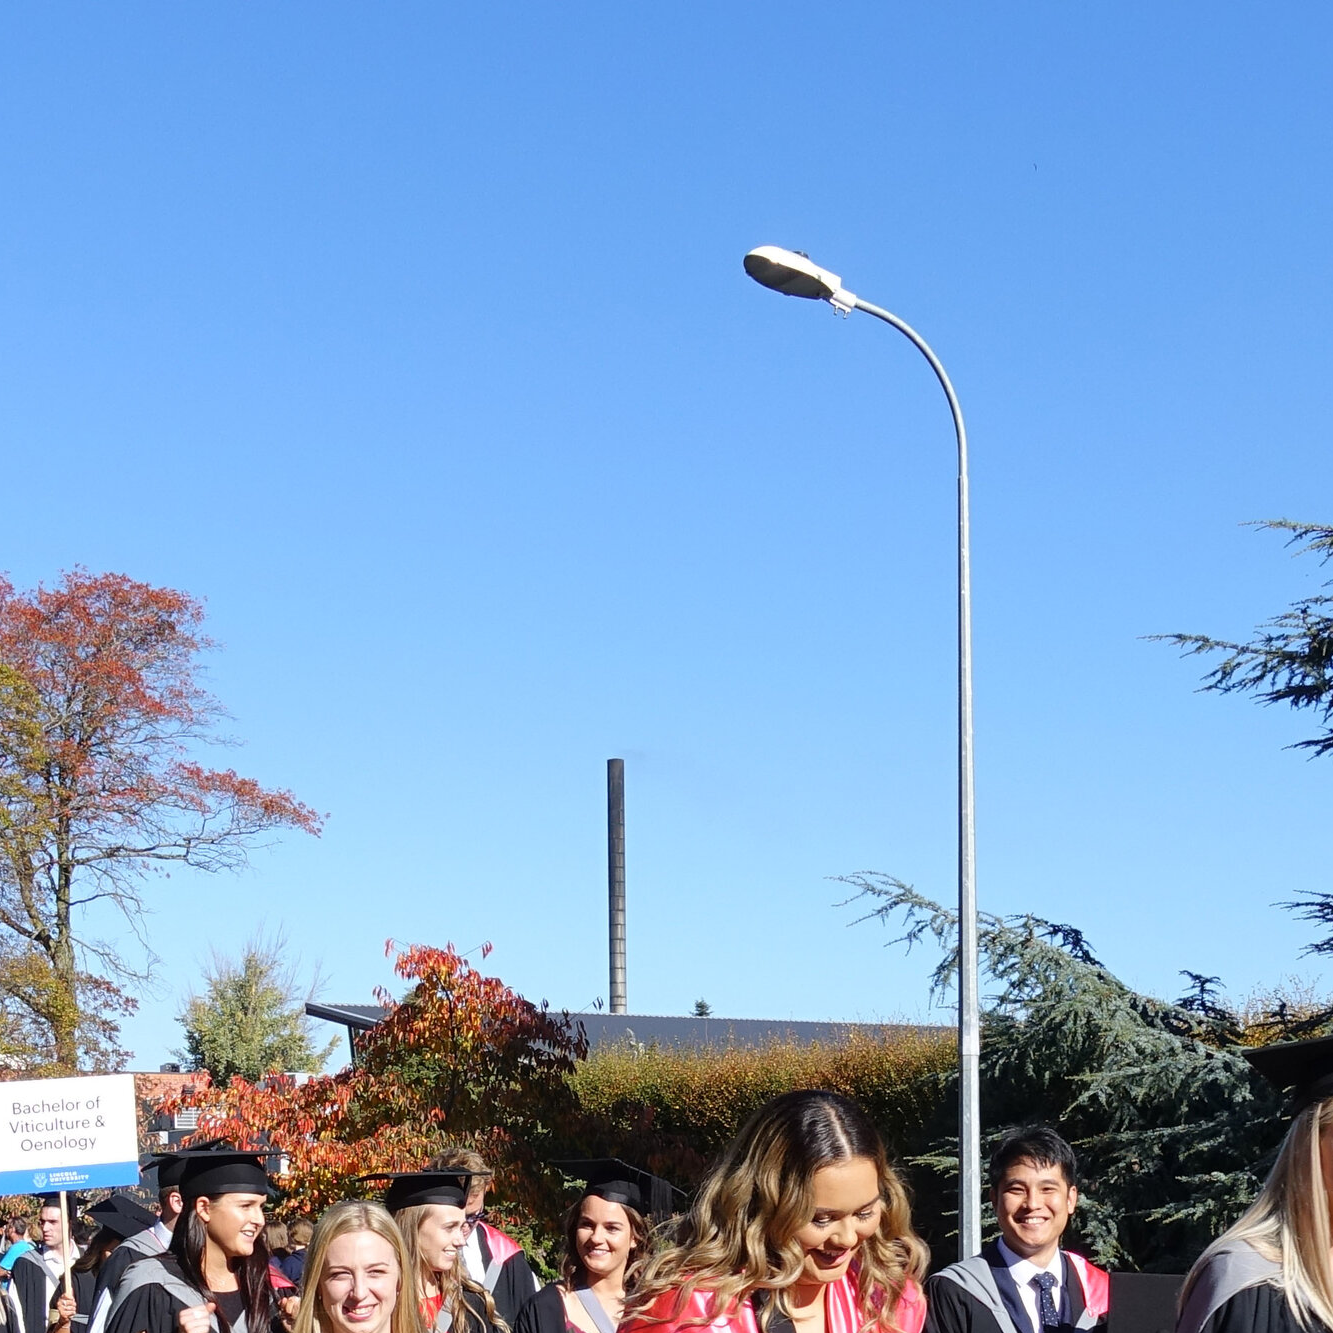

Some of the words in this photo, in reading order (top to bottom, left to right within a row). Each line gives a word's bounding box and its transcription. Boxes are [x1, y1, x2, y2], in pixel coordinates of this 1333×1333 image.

[12, 1098, 81, 1115] Bachelor
[85, 1096, 100, 1110] of
[9, 1117, 90, 1134] Viticulture
[95, 1115, 106, 1128] &
[20, 1136, 97, 1152] Oenology
[49, 1174, 89, 1183] UNIVERSITY
